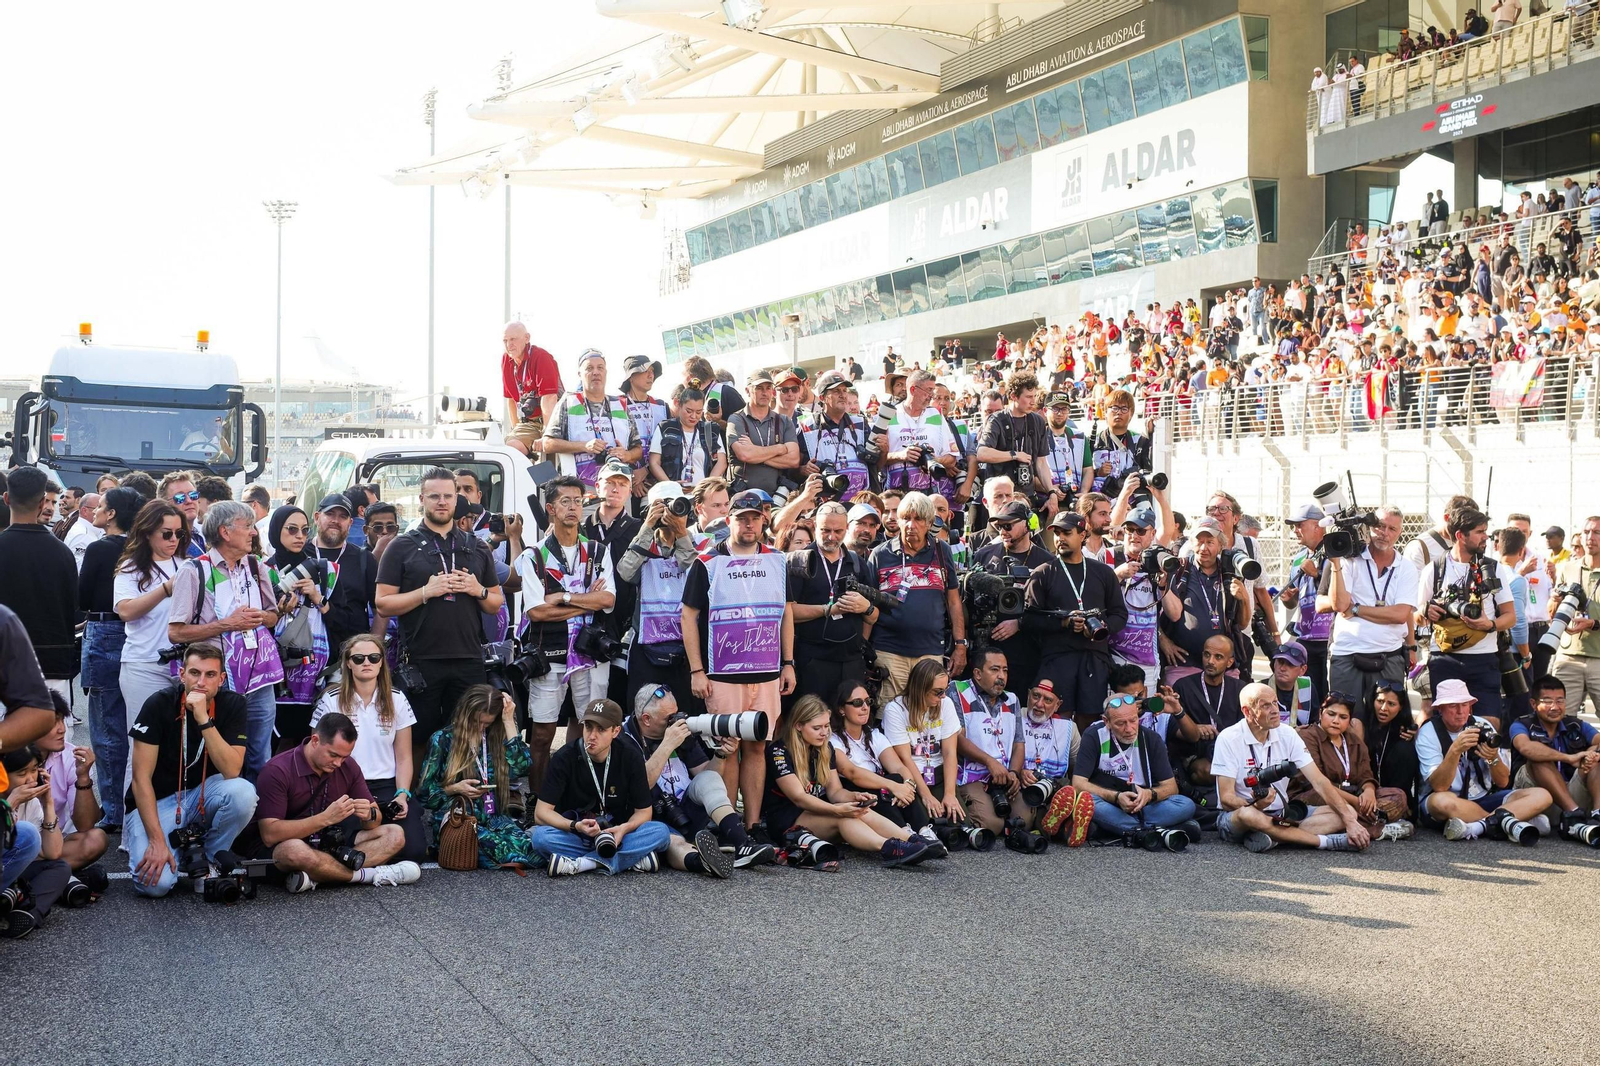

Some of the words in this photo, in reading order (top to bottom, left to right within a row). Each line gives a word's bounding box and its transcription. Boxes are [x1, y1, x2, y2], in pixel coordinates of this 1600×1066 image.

[1006, 72, 1022, 88] ABU
[1023, 60, 1048, 82] DHABI
[1049, 47, 1086, 72] AVIATION
[1087, 43, 1094, 55] &
[1095, 19, 1146, 52] AEROSPACE
[1451, 94, 1484, 110] ETIHAD
[882, 127, 895, 139] ABU
[895, 116, 915, 134] DHABI
[915, 106, 943, 126] AVIATION
[943, 103, 950, 112] &
[950, 85, 989, 110] AEROSPACE
[836, 142, 856, 160] ADGM
[1101, 128, 1197, 192] ALDAR
[791, 161, 810, 178] ADGM
[751, 178, 768, 195] ADGM
[939, 186, 1010, 239] ALDAR
[727, 570, 767, 580] 1546-ABU
[710, 607, 756, 621] MEDIA
[717, 632, 743, 658] Yas
[1453, 633, 1468, 644] NIKE
[132, 722, 150, 734] 44
